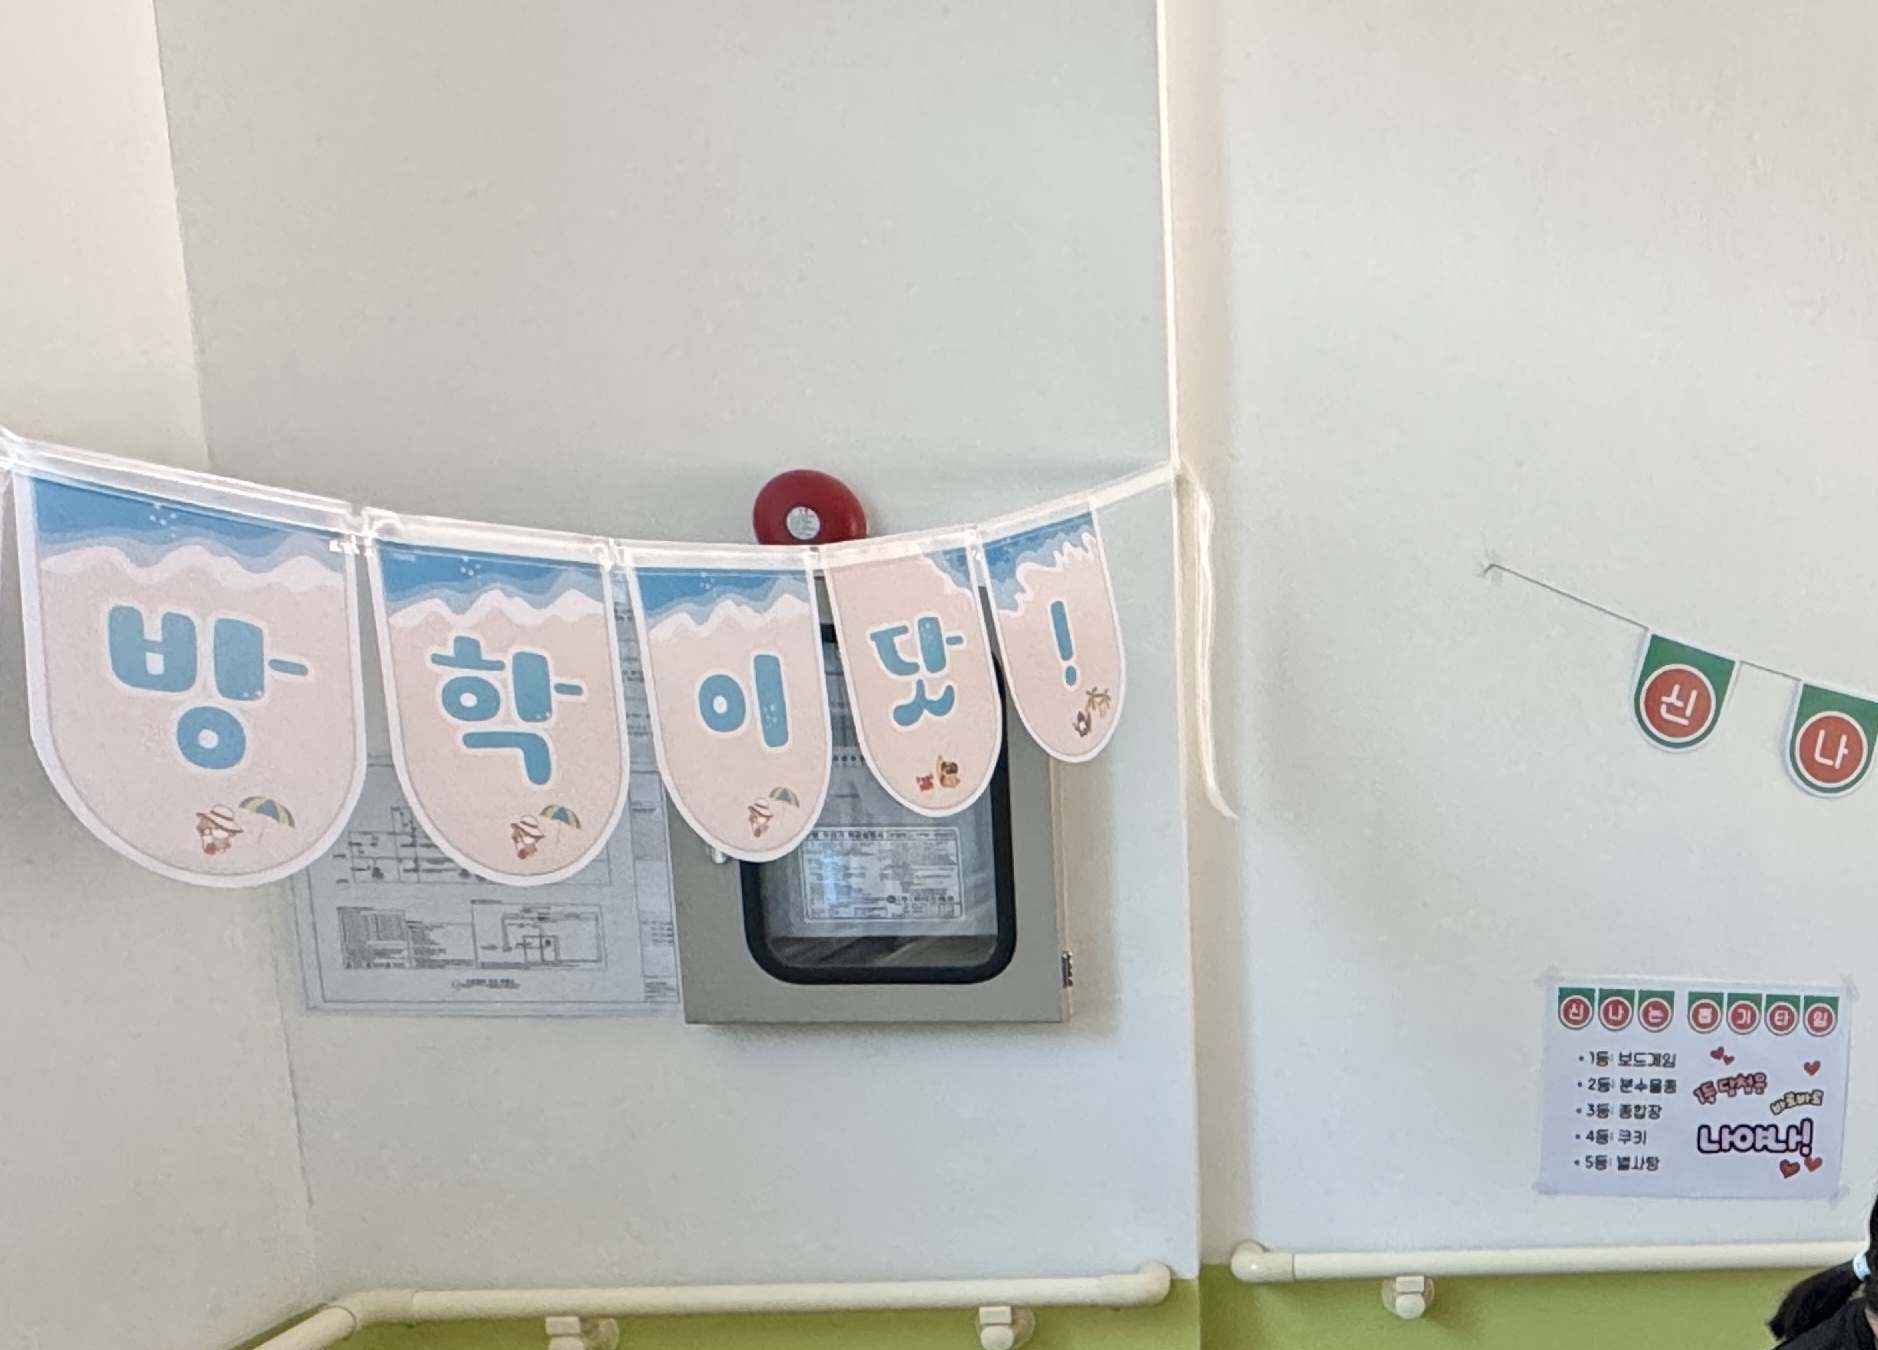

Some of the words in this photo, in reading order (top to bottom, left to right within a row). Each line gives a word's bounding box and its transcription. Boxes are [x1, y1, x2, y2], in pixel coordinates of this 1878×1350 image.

[1618, 1051, 1676, 1068] 보드게임
[1619, 1078, 1677, 1094] 분수물총
[1770, 1088, 1825, 1116] 바로바로
[1618, 1104, 1662, 1120] 종합장
[1617, 1129, 1648, 1145] 쿠키
[1616, 1155, 1660, 1172] 별사탕
